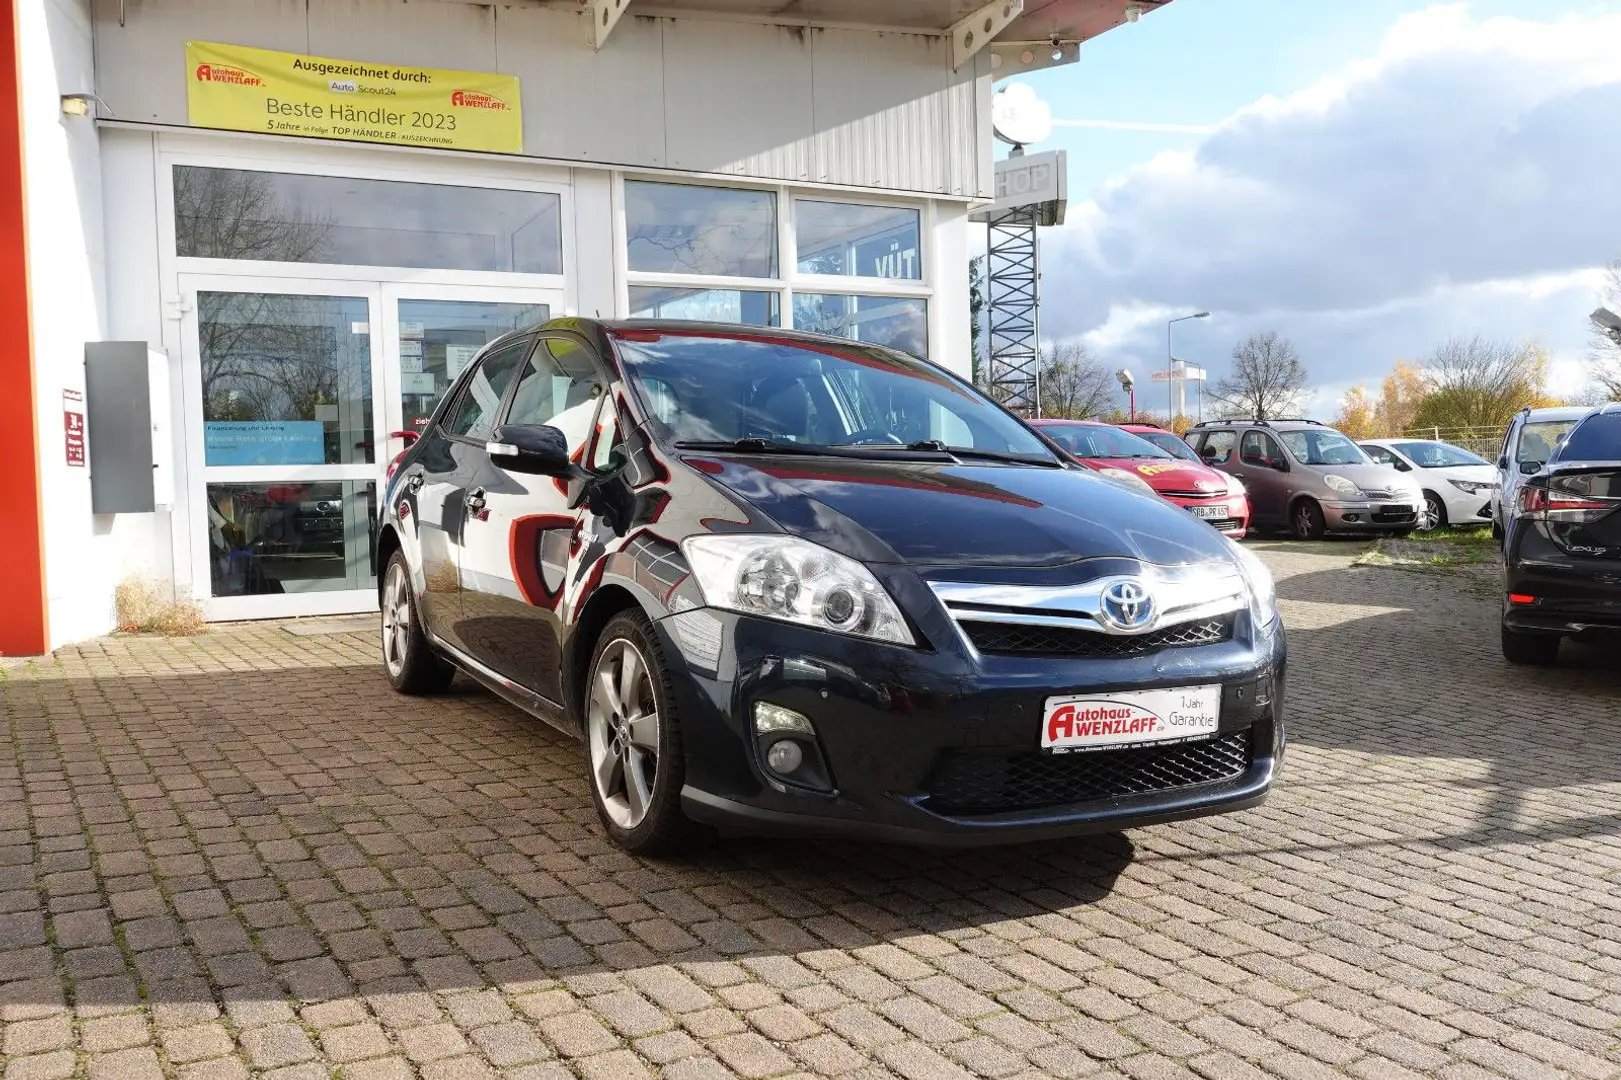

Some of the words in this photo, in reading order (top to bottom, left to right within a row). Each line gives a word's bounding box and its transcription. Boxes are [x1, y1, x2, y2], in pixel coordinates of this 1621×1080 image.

[293, 59, 388, 79] Ausgezeichnet
[392, 69, 432, 83] durch:
[211, 75, 262, 87] WENZLAFF
[267, 98, 324, 119] Beste
[330, 103, 406, 127] Händler
[411, 111, 456, 131] 2023
[464, 99, 506, 111] WENZLAFF
[267, 120, 274, 130] 5
[275, 121, 301, 131] Jahre
[332, 127, 351, 135] TOP
[353, 127, 397, 139] HÄNDLER
[996, 168, 1048, 198] HOP
[1566, 544, 1607, 553] LEXUS
[1075, 716, 1157, 737] WENZLAFF
[1169, 711, 1214, 727] Garantie
